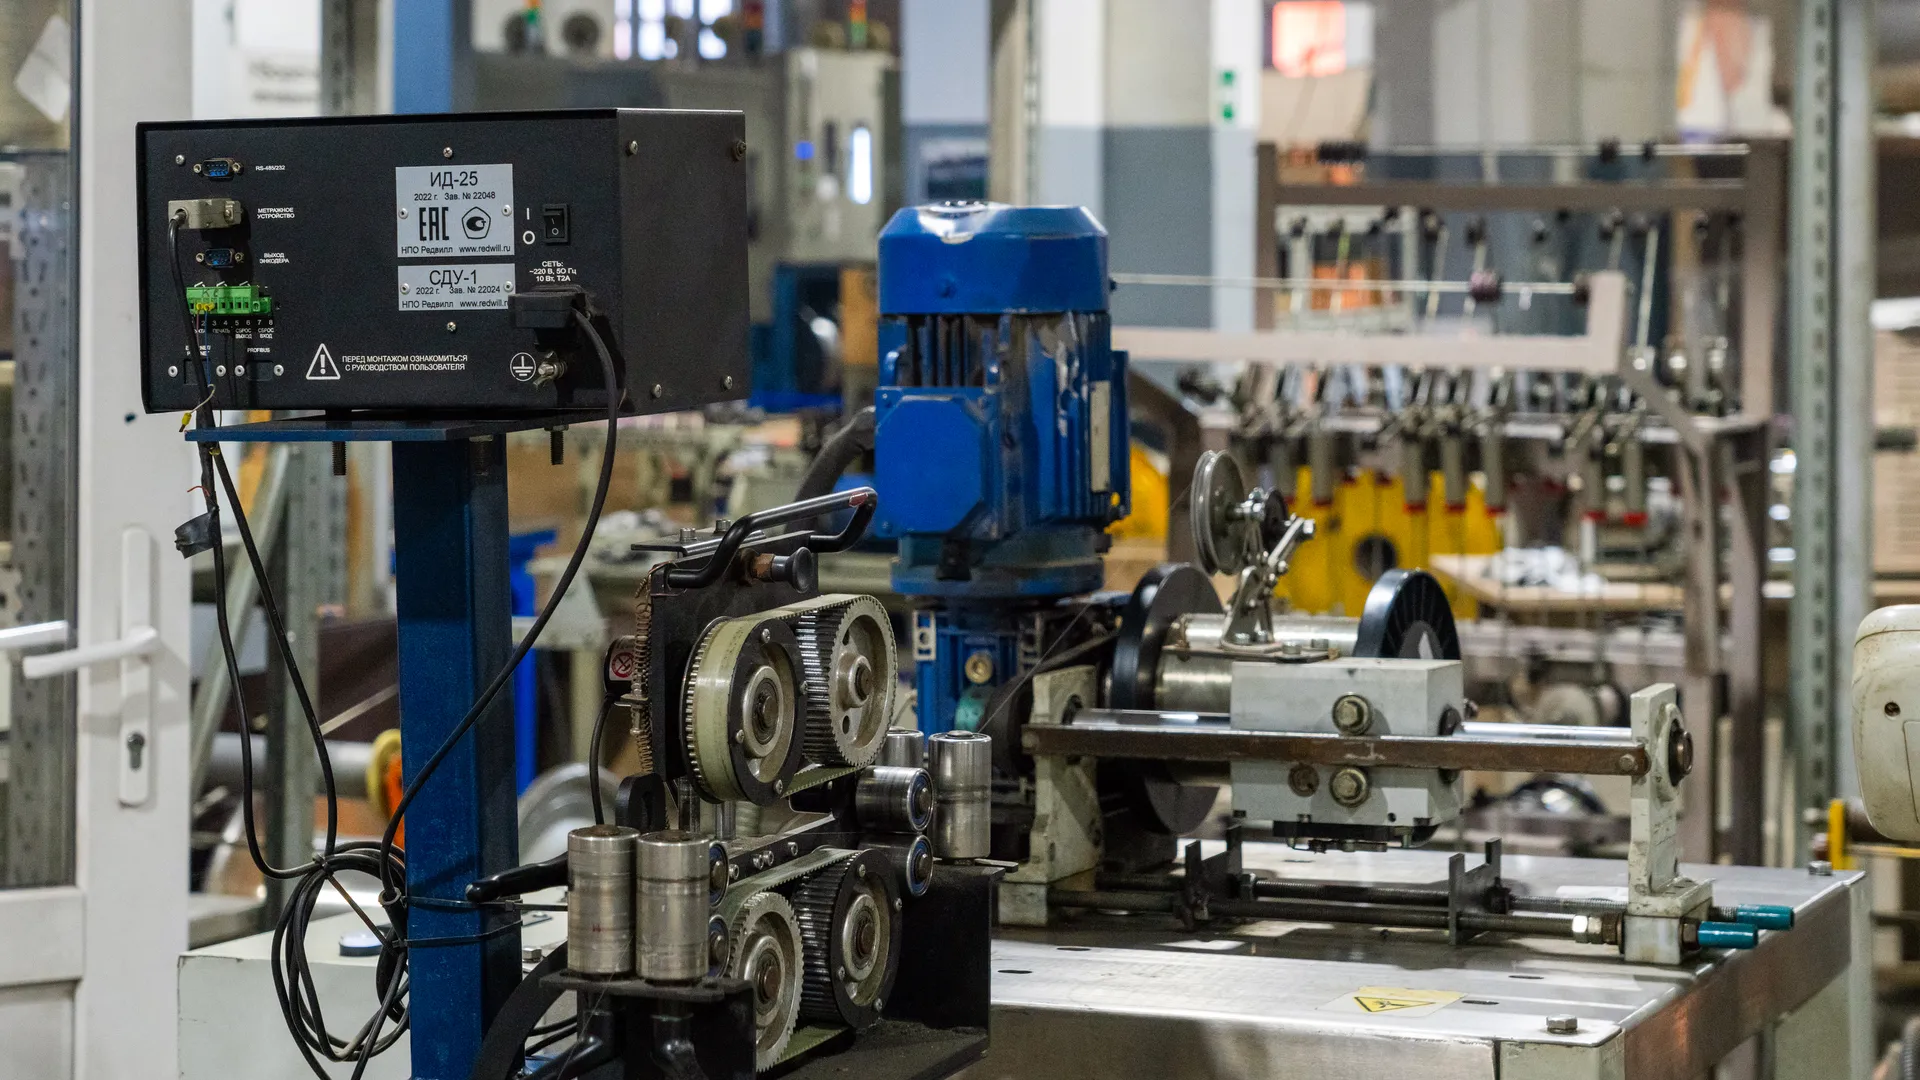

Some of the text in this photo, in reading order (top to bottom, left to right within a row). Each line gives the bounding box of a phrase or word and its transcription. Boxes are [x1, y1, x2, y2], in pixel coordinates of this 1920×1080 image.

[430, 170, 478, 190] ИД-25
[414, 192, 432, 202] 2022
[444, 192, 460, 200] Зав.
[472, 192, 496, 200] 22048
[400, 244, 510, 254] НПО Редвилл www.redwill.ru
[430, 270, 476, 288] СДУ-1
[416, 286, 434, 294] 2022
[448, 286, 464, 294] Зав.
[468, 286, 476, 294] №
[478, 286, 500, 294] 22024
[402, 300, 420, 308] НПО
[422, 300, 454, 308] Редвилл
[342, 356, 366, 364] ПЕРЕД
[410, 354, 468, 362] ОЗНАКОМИТЬСЯ
[352, 364, 408, 372] РУКОВОДСТВОМ
